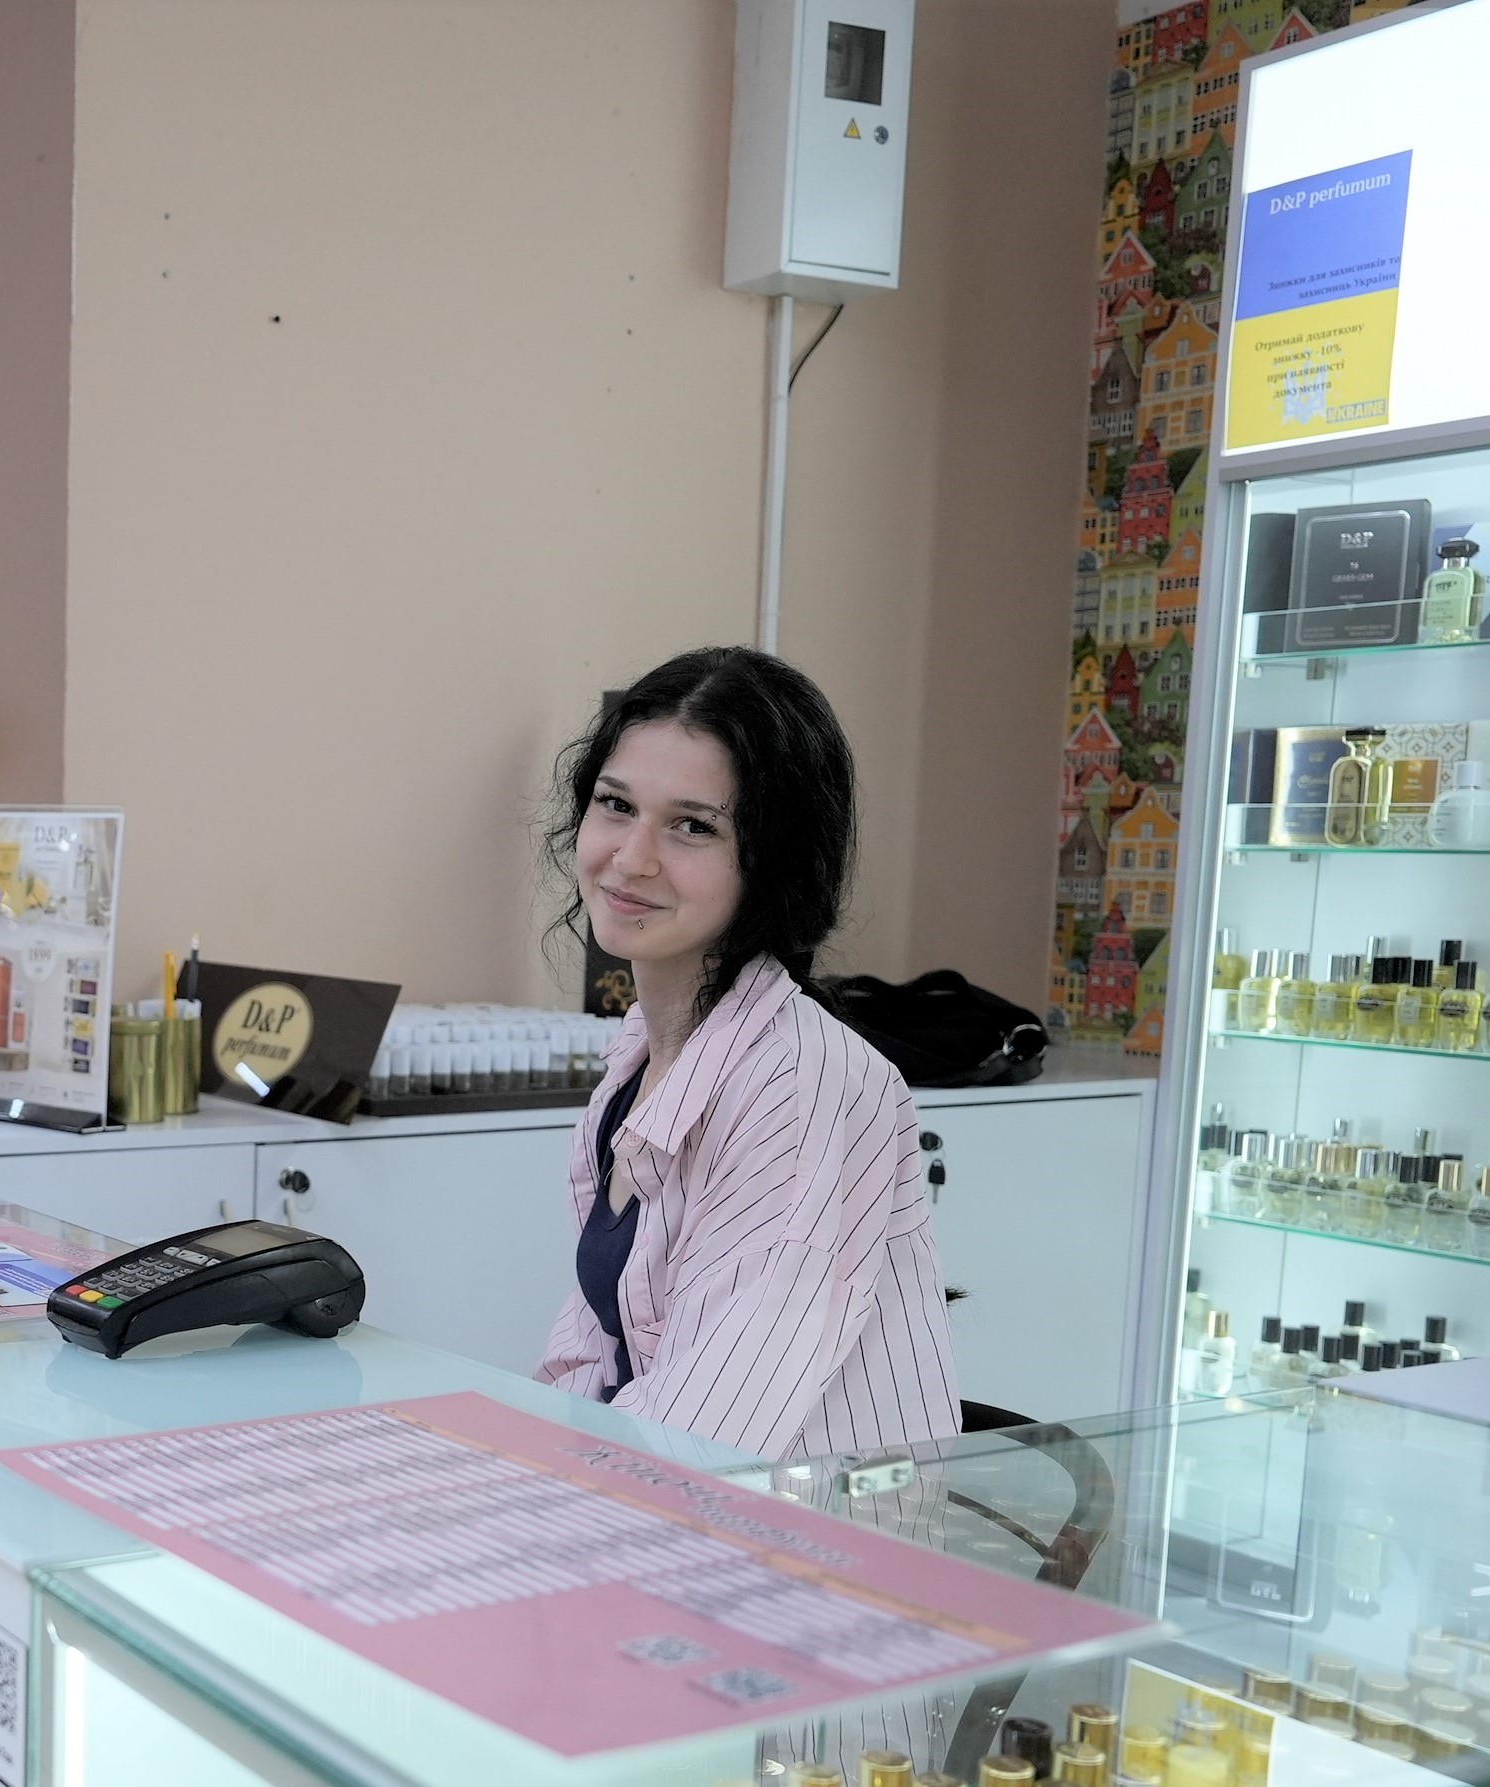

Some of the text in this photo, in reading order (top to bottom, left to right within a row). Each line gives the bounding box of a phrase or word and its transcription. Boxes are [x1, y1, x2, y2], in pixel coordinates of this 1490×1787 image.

[1269, 172, 1392, 216] D&P perfumum
[1354, 272, 1396, 289] України
[1255, 323, 1365, 352] Отримай додаткову
[1290, 359, 1345, 380] наявності
[1273, 381, 1332, 400] документа
[241, 1000, 295, 1034] D&P
[220, 1033, 293, 1062] perfumum
